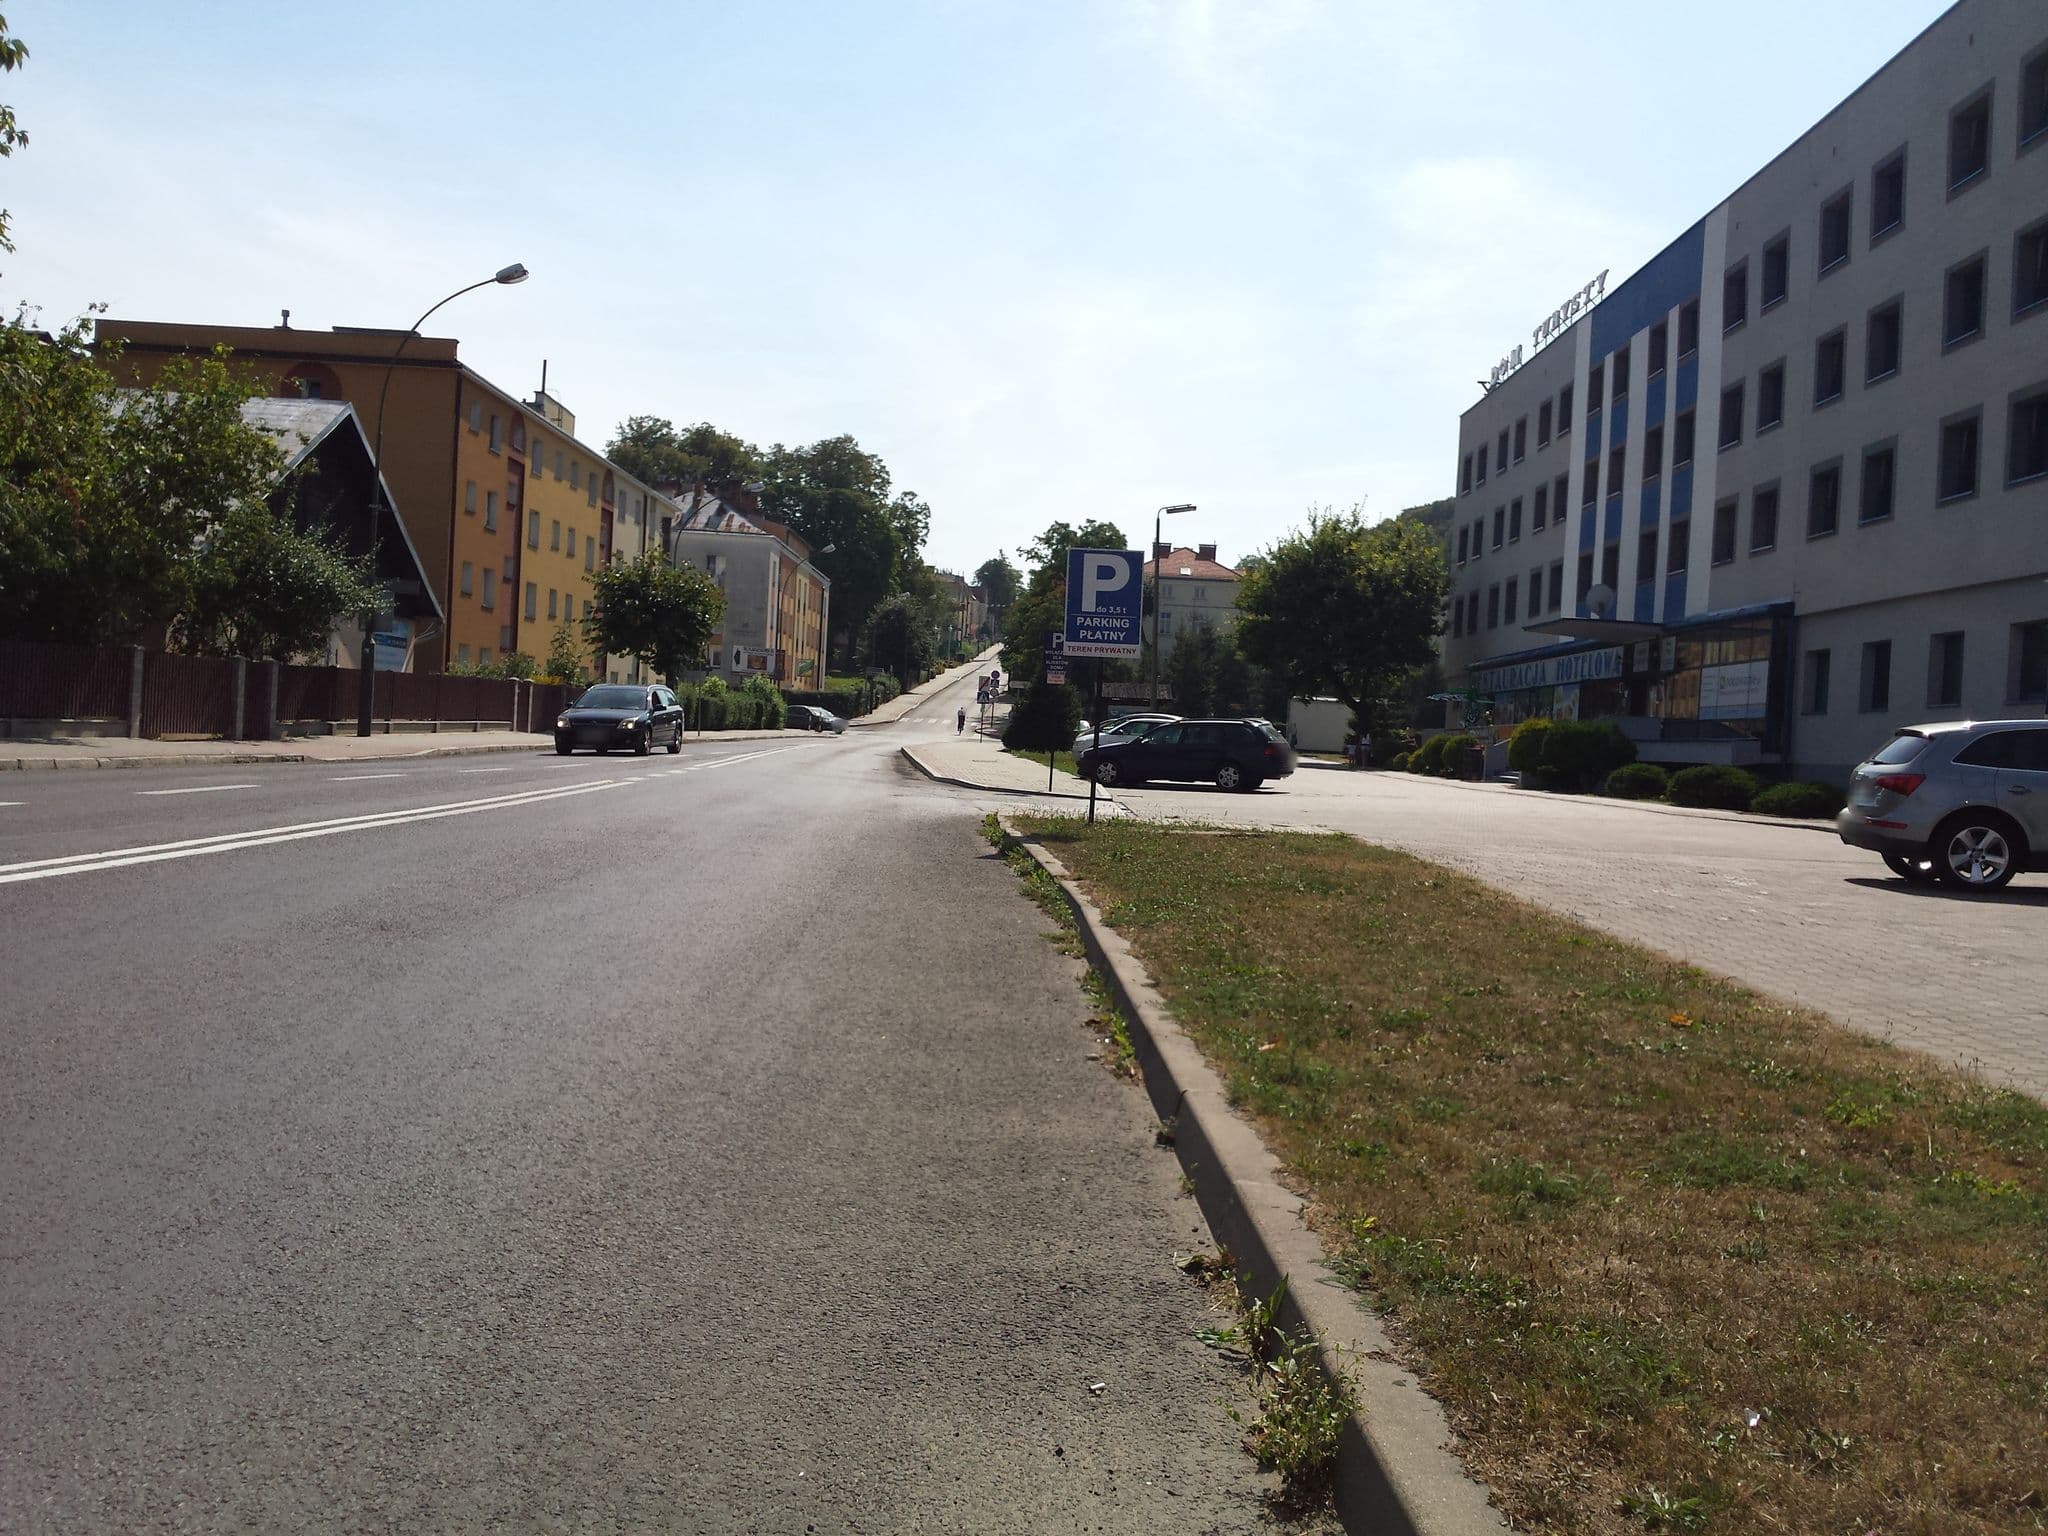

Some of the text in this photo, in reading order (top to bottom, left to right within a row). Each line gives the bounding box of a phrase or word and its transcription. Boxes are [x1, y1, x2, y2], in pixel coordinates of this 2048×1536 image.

[1081, 553, 1130, 612] P
[1076, 617, 1130, 628] PARKING
[1052, 632, 1064, 648] P
[1079, 630, 1127, 641] PŁATNY
[1067, 645, 1137, 655] TEREN PRYWATNY
